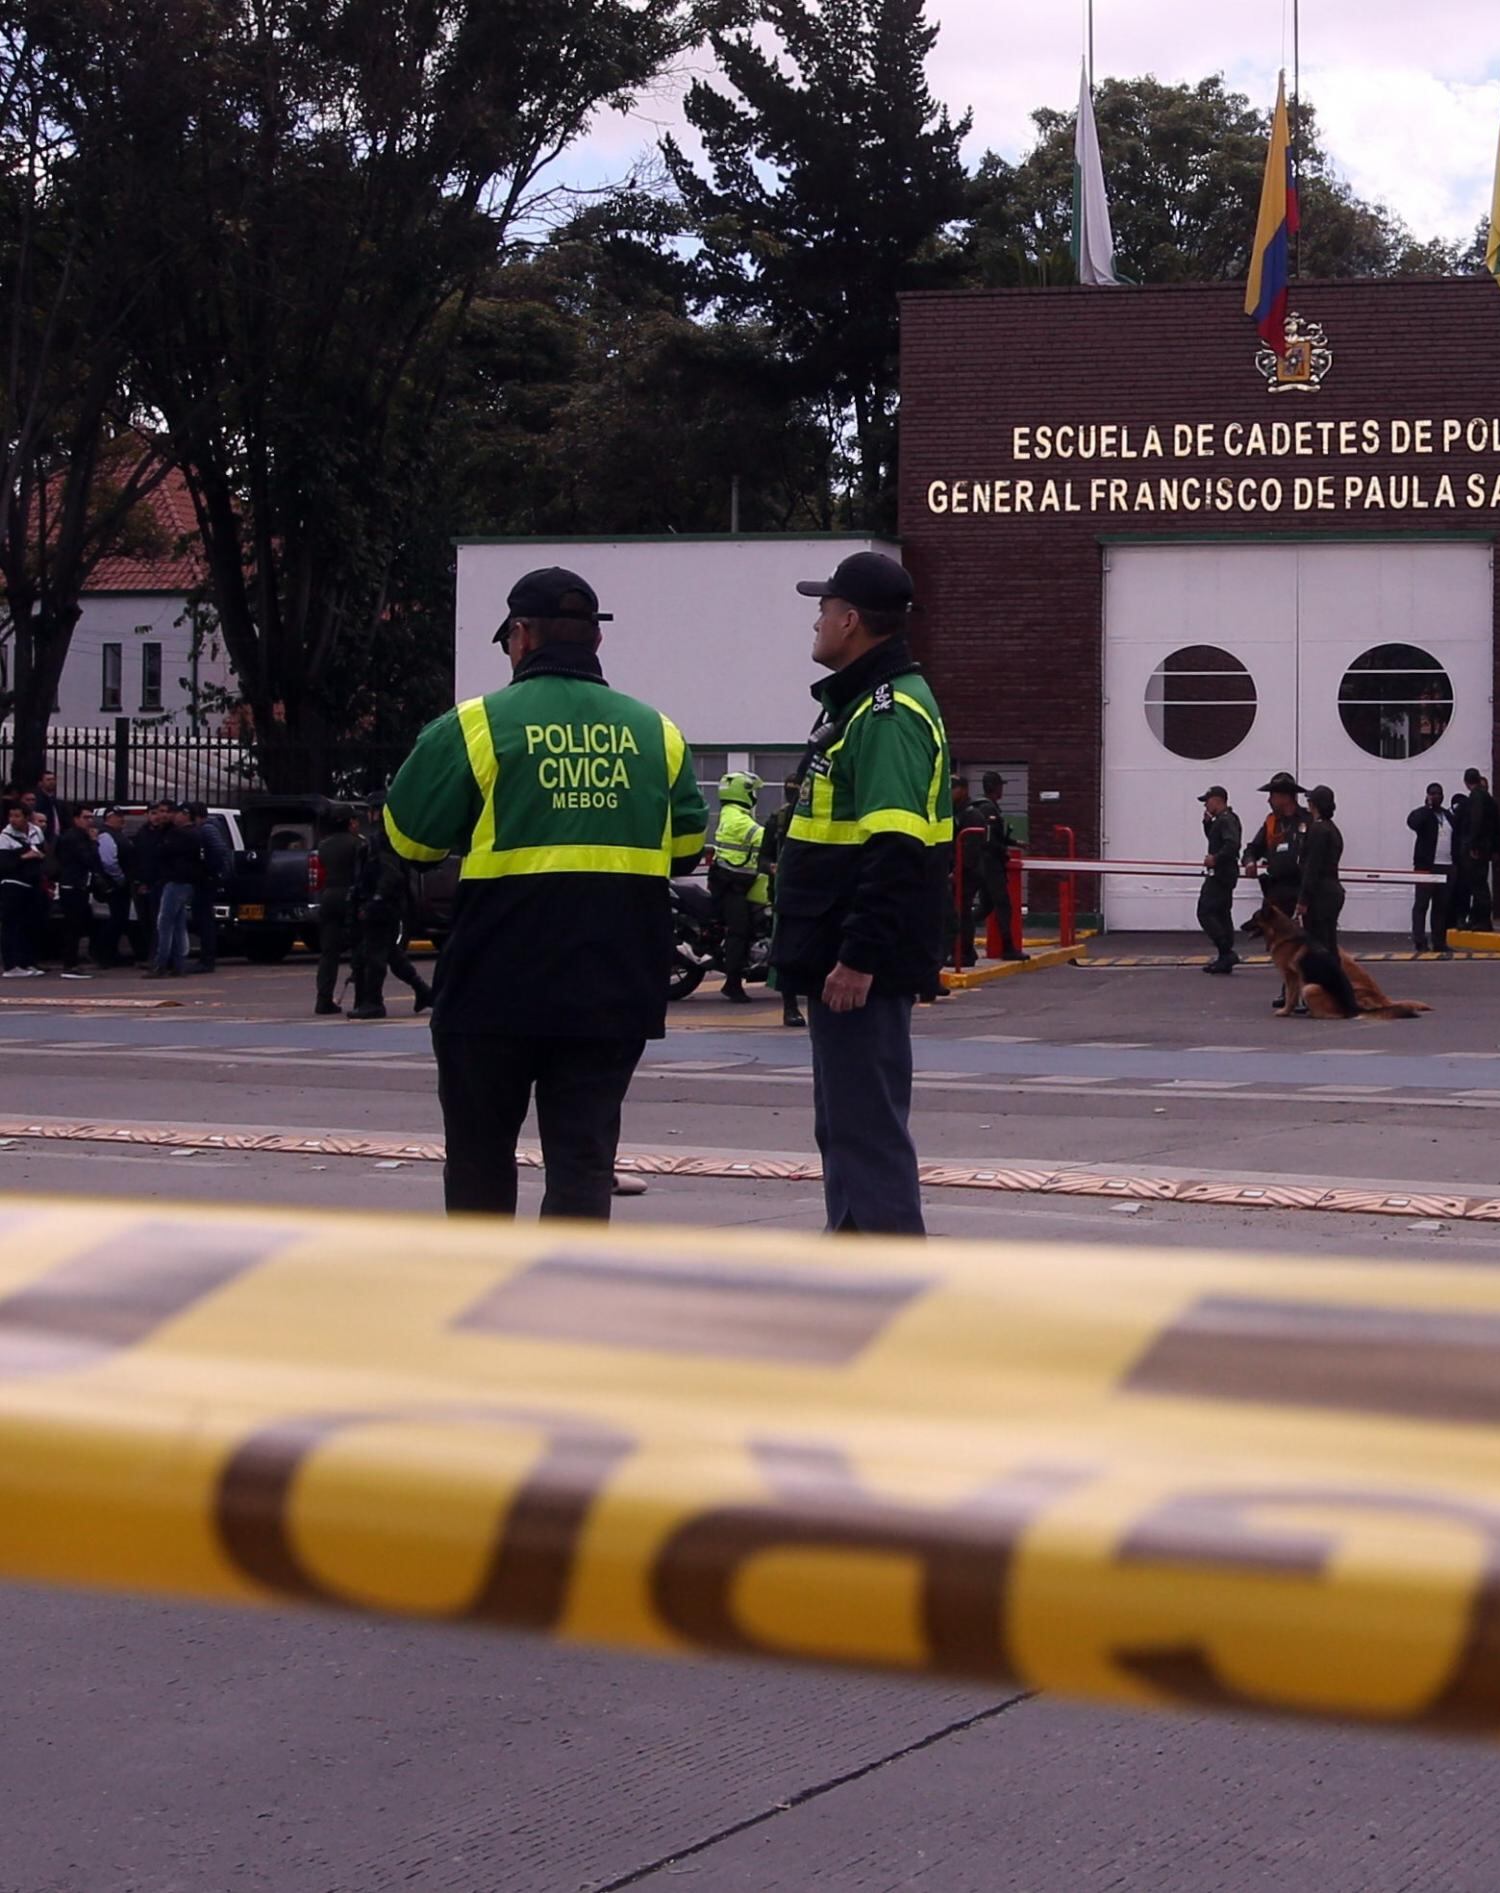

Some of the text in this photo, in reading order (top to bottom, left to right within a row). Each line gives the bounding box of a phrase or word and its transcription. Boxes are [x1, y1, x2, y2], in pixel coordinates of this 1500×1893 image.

[1013, 425, 1163, 460] ESCUELA
[1174, 424, 1215, 457] DE
[1224, 420, 1380, 456] CADETES
[1391, 420, 1433, 453] DE
[927, 479, 1081, 514] GENERAL
[1090, 477, 1282, 512] FRANCISCO
[1294, 476, 1336, 511] DE
[1344, 475, 1456, 510] PAULA
[525, 724, 640, 755] POLICIA
[538, 757, 631, 789] CIVICA
[552, 792, 618, 809] MEBOG
